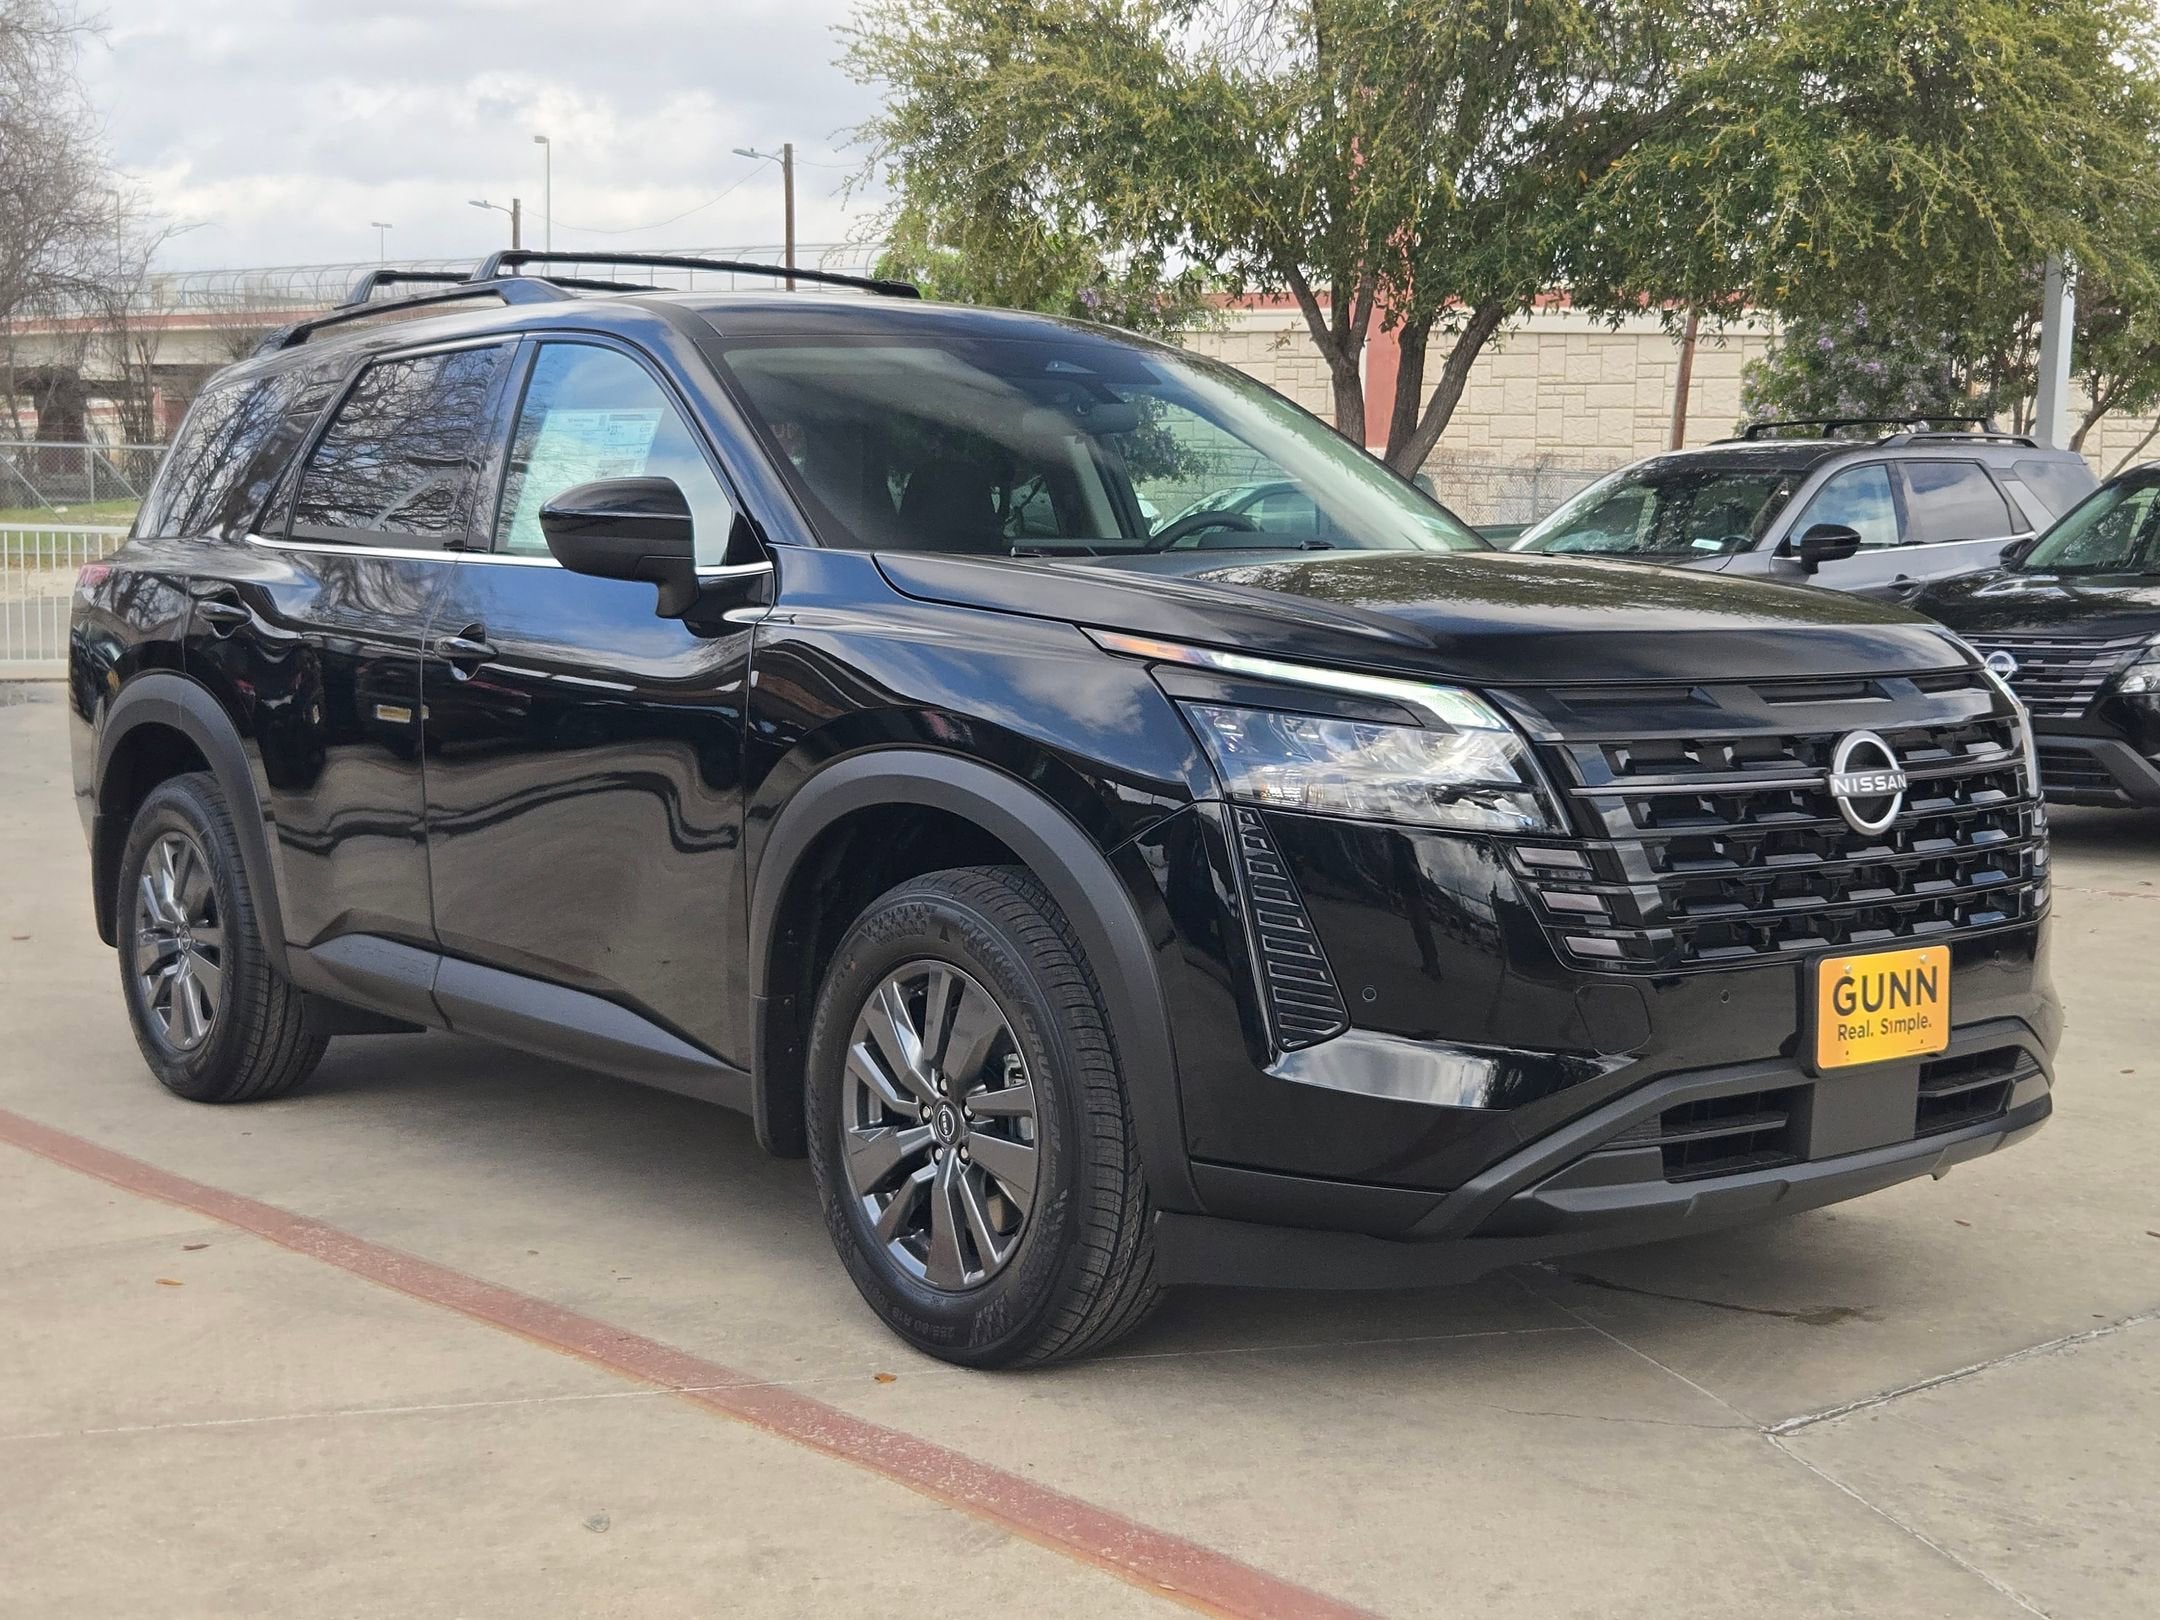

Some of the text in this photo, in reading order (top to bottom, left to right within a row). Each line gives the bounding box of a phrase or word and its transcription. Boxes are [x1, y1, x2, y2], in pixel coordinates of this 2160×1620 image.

[1833, 774, 1908, 794] NISSAN
[1832, 965, 1938, 1017] GUNN
[1837, 1012, 1933, 1042] Real. Simple.
